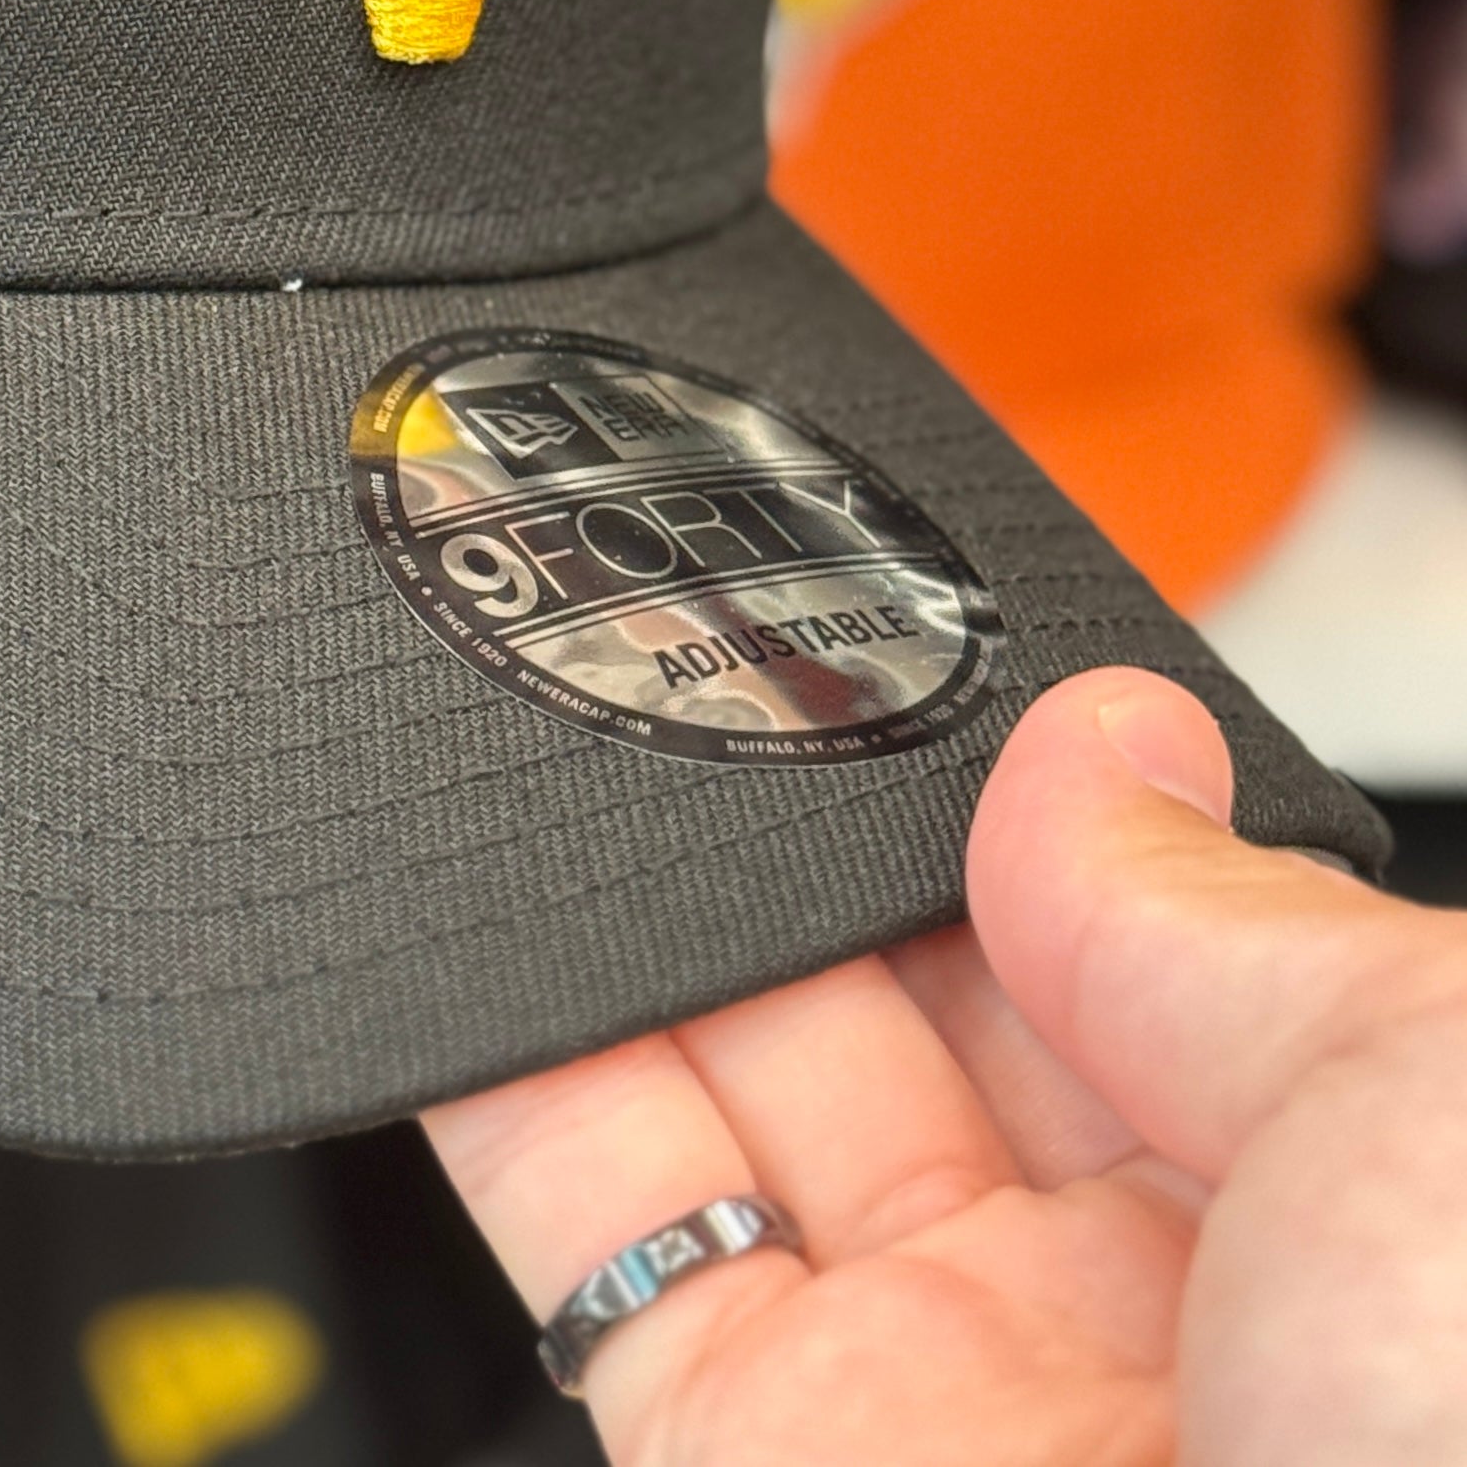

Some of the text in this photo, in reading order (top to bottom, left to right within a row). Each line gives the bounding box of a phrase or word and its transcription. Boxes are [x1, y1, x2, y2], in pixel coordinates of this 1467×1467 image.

[579, 392, 667, 421] NEW
[603, 415, 687, 442] ERA
[440, 481, 883, 619] 9FORTY
[397, 554, 421, 581] USA
[433, 602, 473, 638] SINCE
[471, 637, 508, 668] 1920
[516, 669, 652, 736] NEWERACAP.COM
[652, 605, 922, 689] ADJUSTABLE
[833, 735, 866, 752] USA
